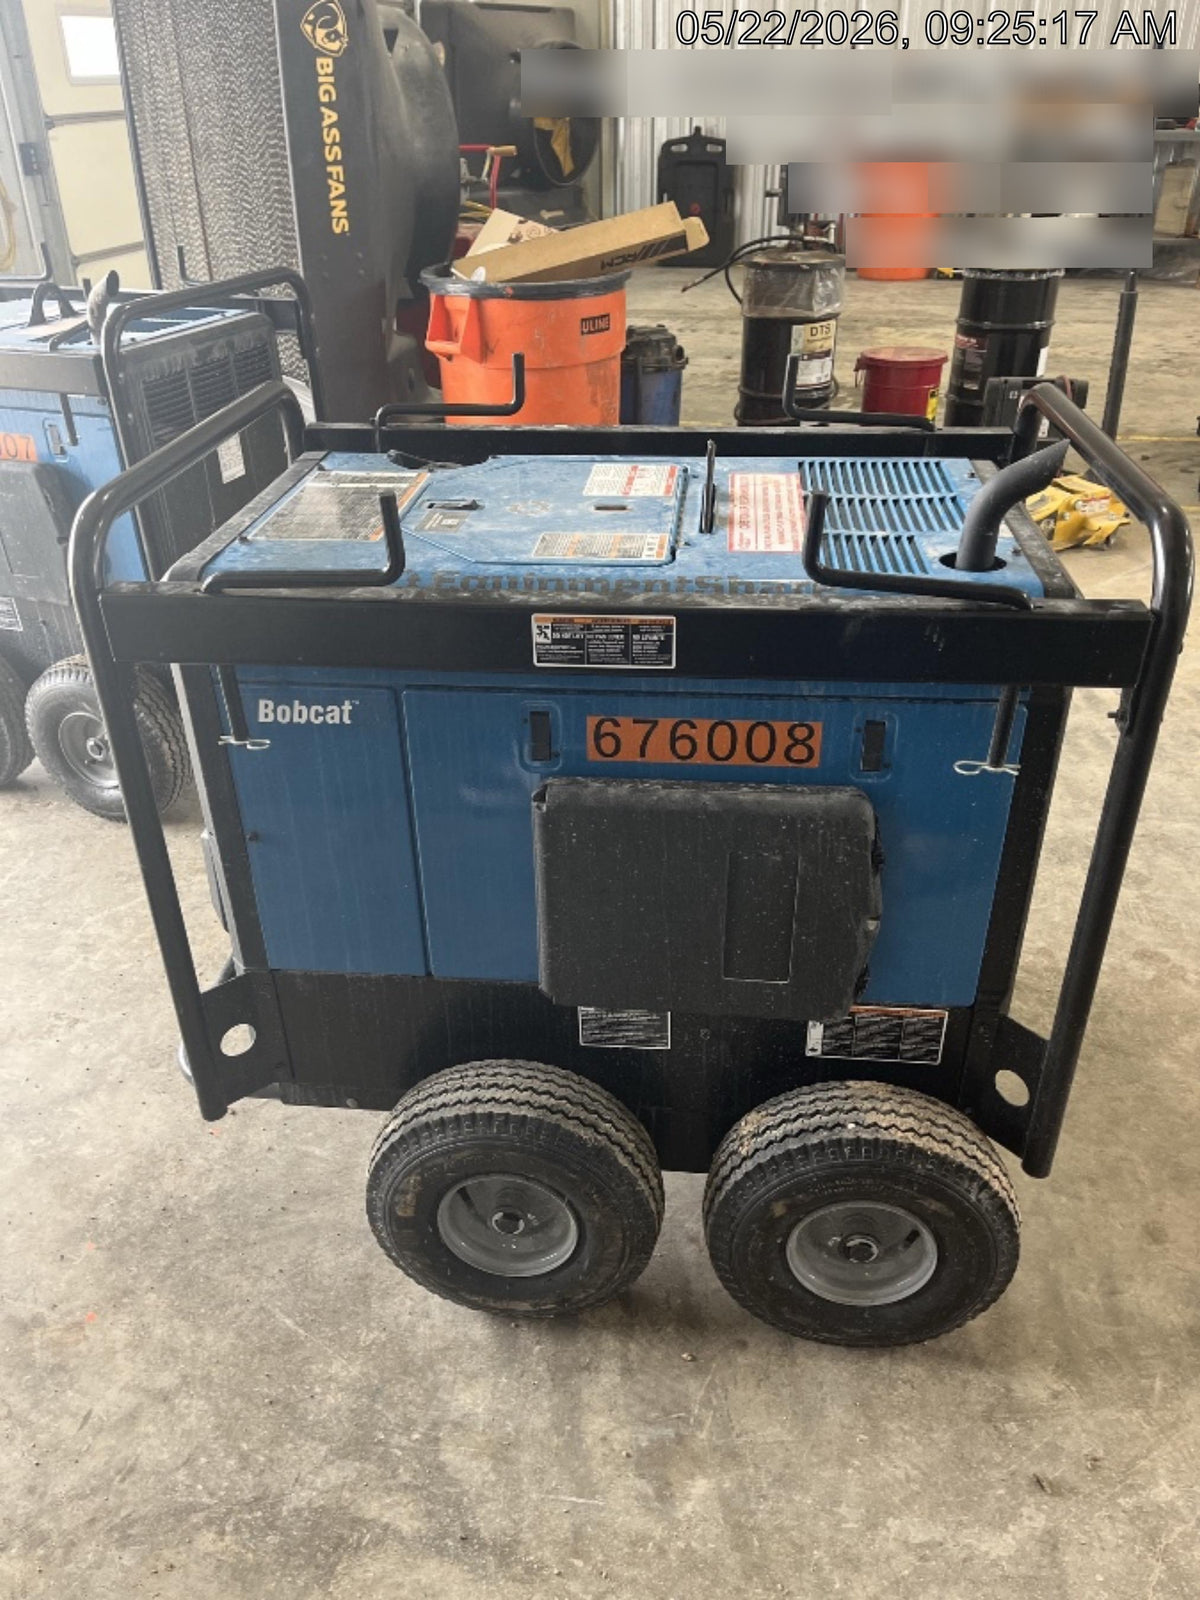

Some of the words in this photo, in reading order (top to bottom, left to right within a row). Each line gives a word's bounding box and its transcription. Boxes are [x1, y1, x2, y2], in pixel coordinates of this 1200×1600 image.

[316, 56, 337, 103] BIG
[320, 106, 343, 163] ASS
[326, 165, 350, 235] FANS
[581, 314, 610, 334] ULINE
[0, 434, 30, 460] 07
[258, 699, 353, 724] Bobcat
[593, 717, 815, 764] 676008
